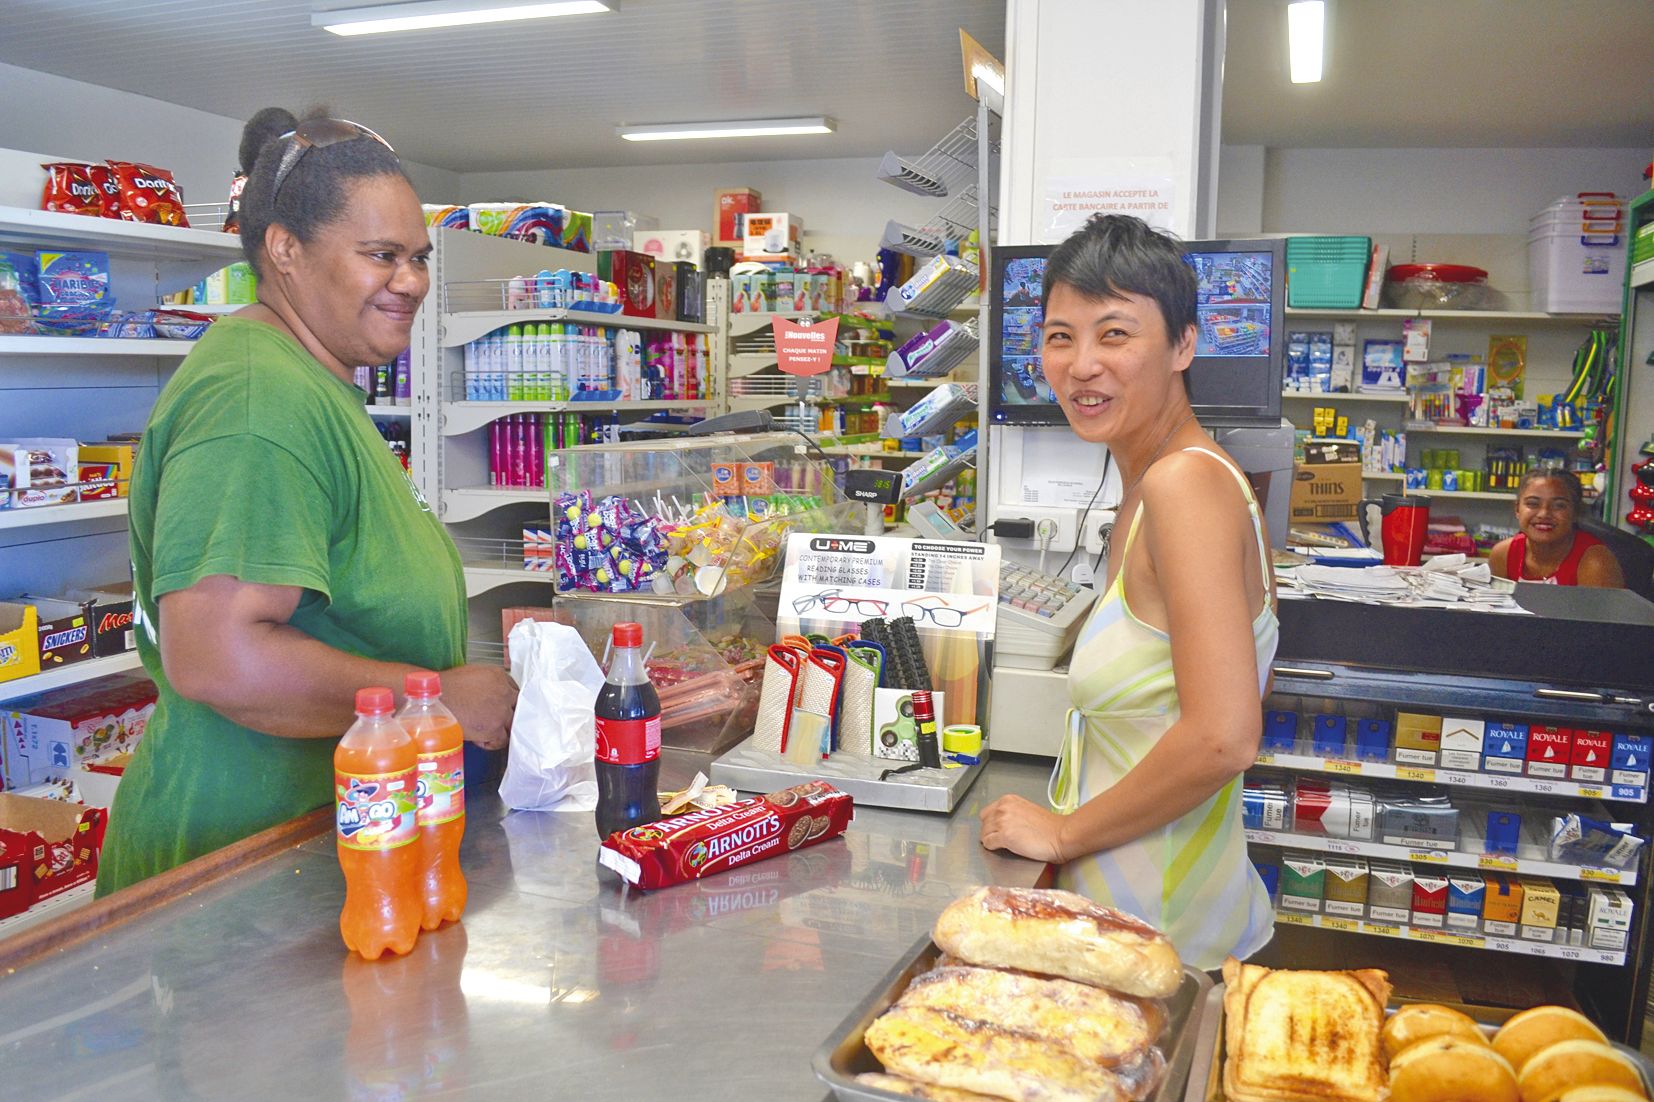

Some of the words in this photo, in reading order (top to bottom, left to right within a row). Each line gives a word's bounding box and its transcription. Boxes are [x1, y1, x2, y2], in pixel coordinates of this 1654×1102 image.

[1113, 190, 1147, 198] ACCEPTE
[1052, 203, 1076, 211] CARTE
[22, 494, 44, 504] duplo
[800, 554, 851, 564] CONTEMPORARY
[819, 576, 856, 584] MATCHING
[98, 612, 133, 634] Mar
[44, 627, 86, 650] SNICKERS
[1490, 730, 1525, 739] ROYALE
[1533, 733, 1568, 743] ROYALE
[1577, 738, 1607, 747] ROYALE
[1618, 743, 1648, 752] ROYALE
[706, 817, 733, 831] Delta
[734, 806, 766, 820] Cream
[1265, 802, 1273, 826] Fumer
[707, 815, 780, 858] ARNOTT'S
[728, 851, 751, 865] Delta
[752, 837, 780, 855] Cream
[1528, 896, 1556, 904] CAMEL
